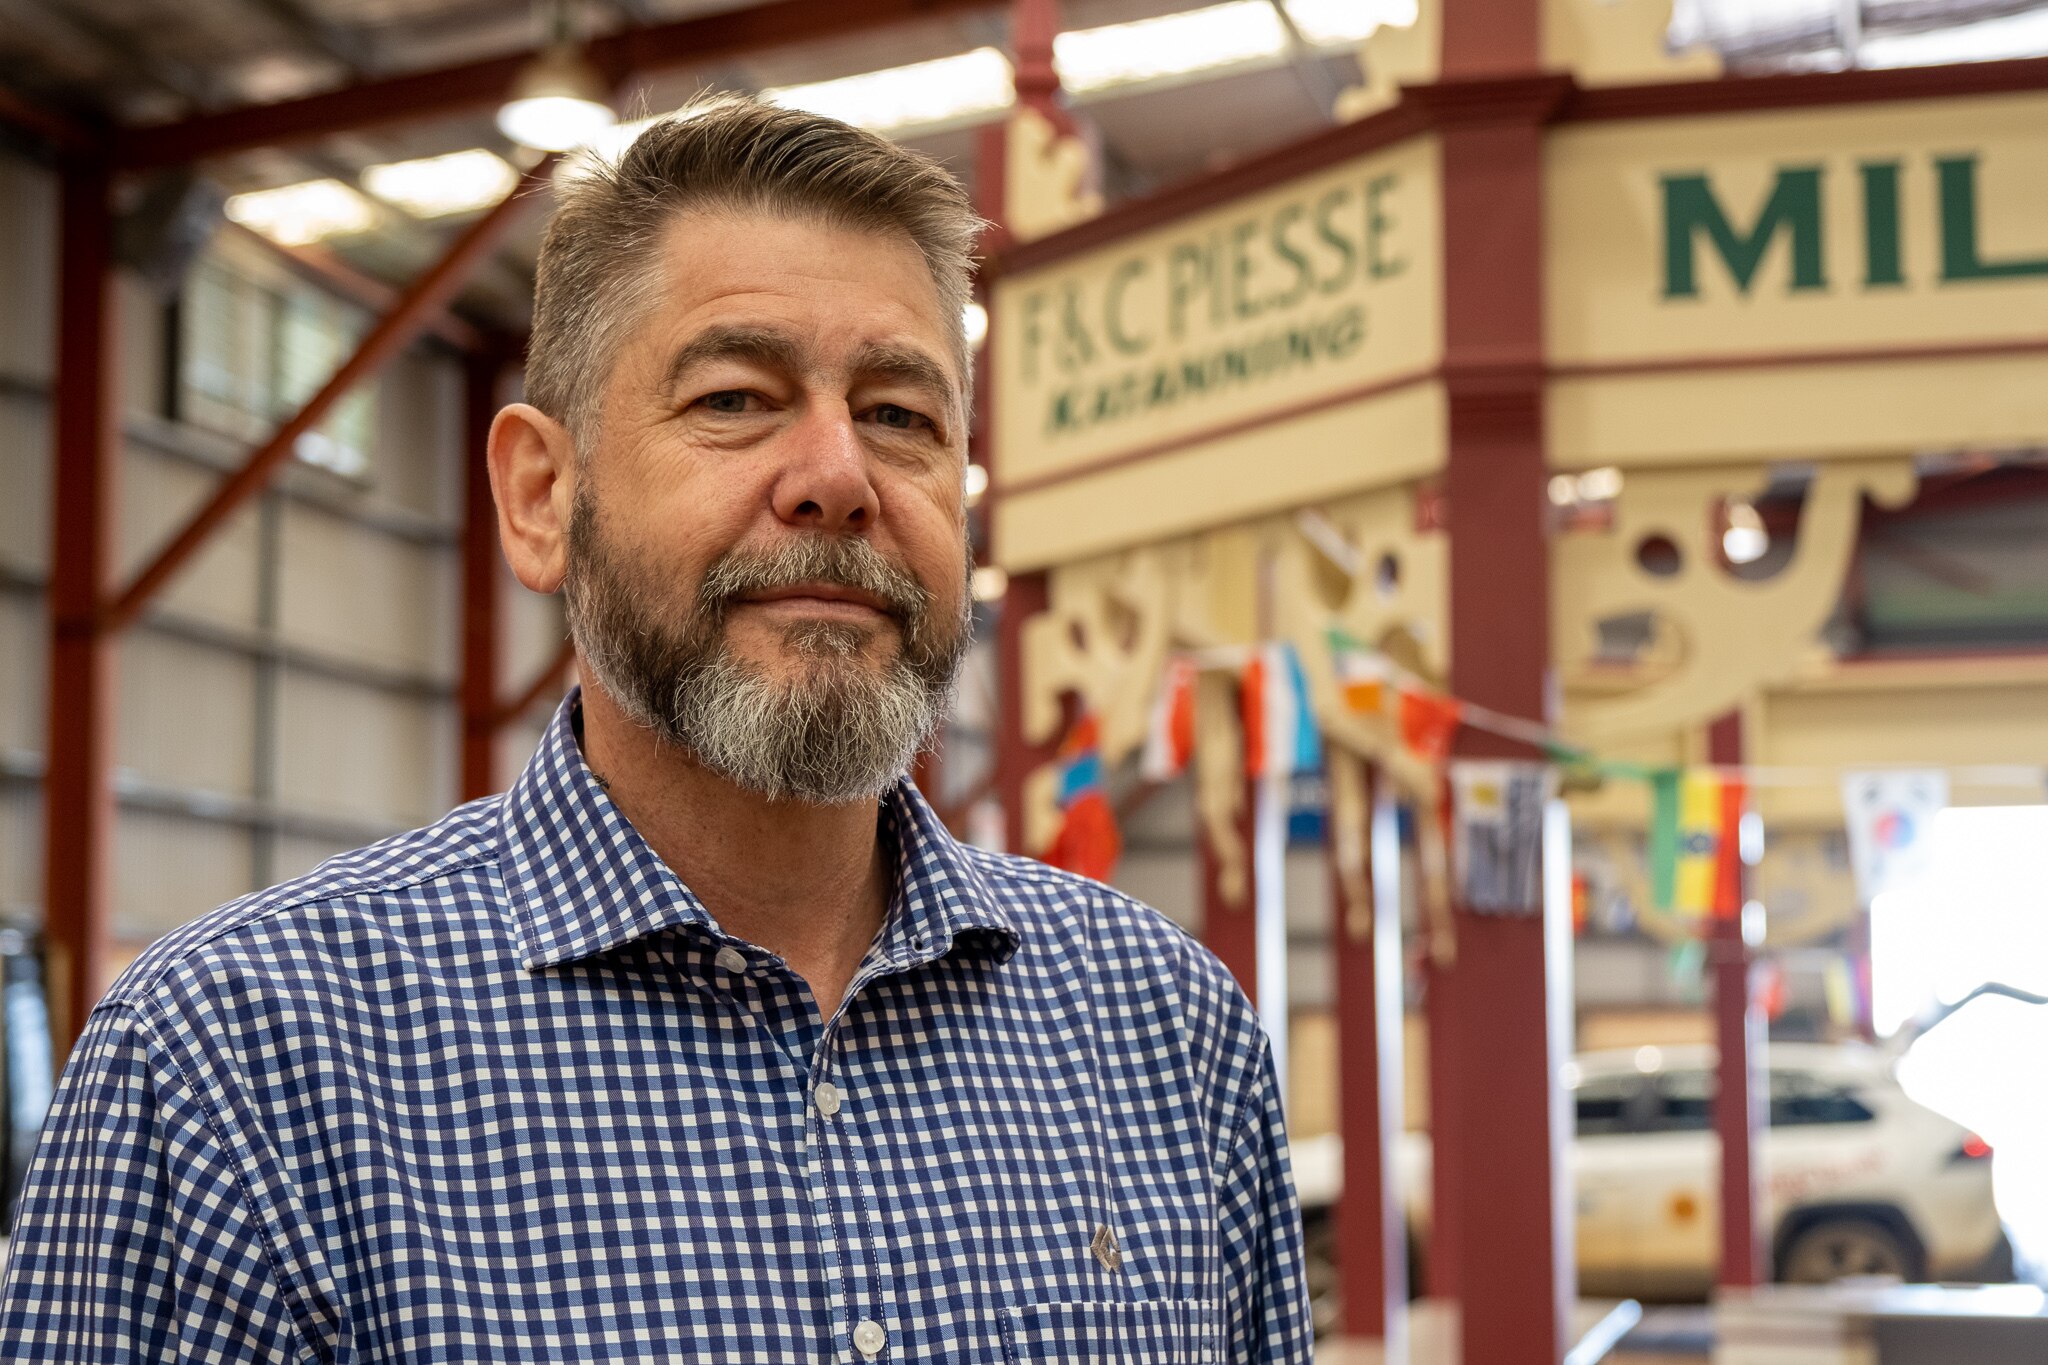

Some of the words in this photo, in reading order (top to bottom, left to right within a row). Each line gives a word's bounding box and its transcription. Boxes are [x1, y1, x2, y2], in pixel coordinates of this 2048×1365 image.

[1168, 175, 1406, 338] PIESSE
[1660, 154, 2048, 300] MIL
[1045, 305, 1366, 434] KATANNING
